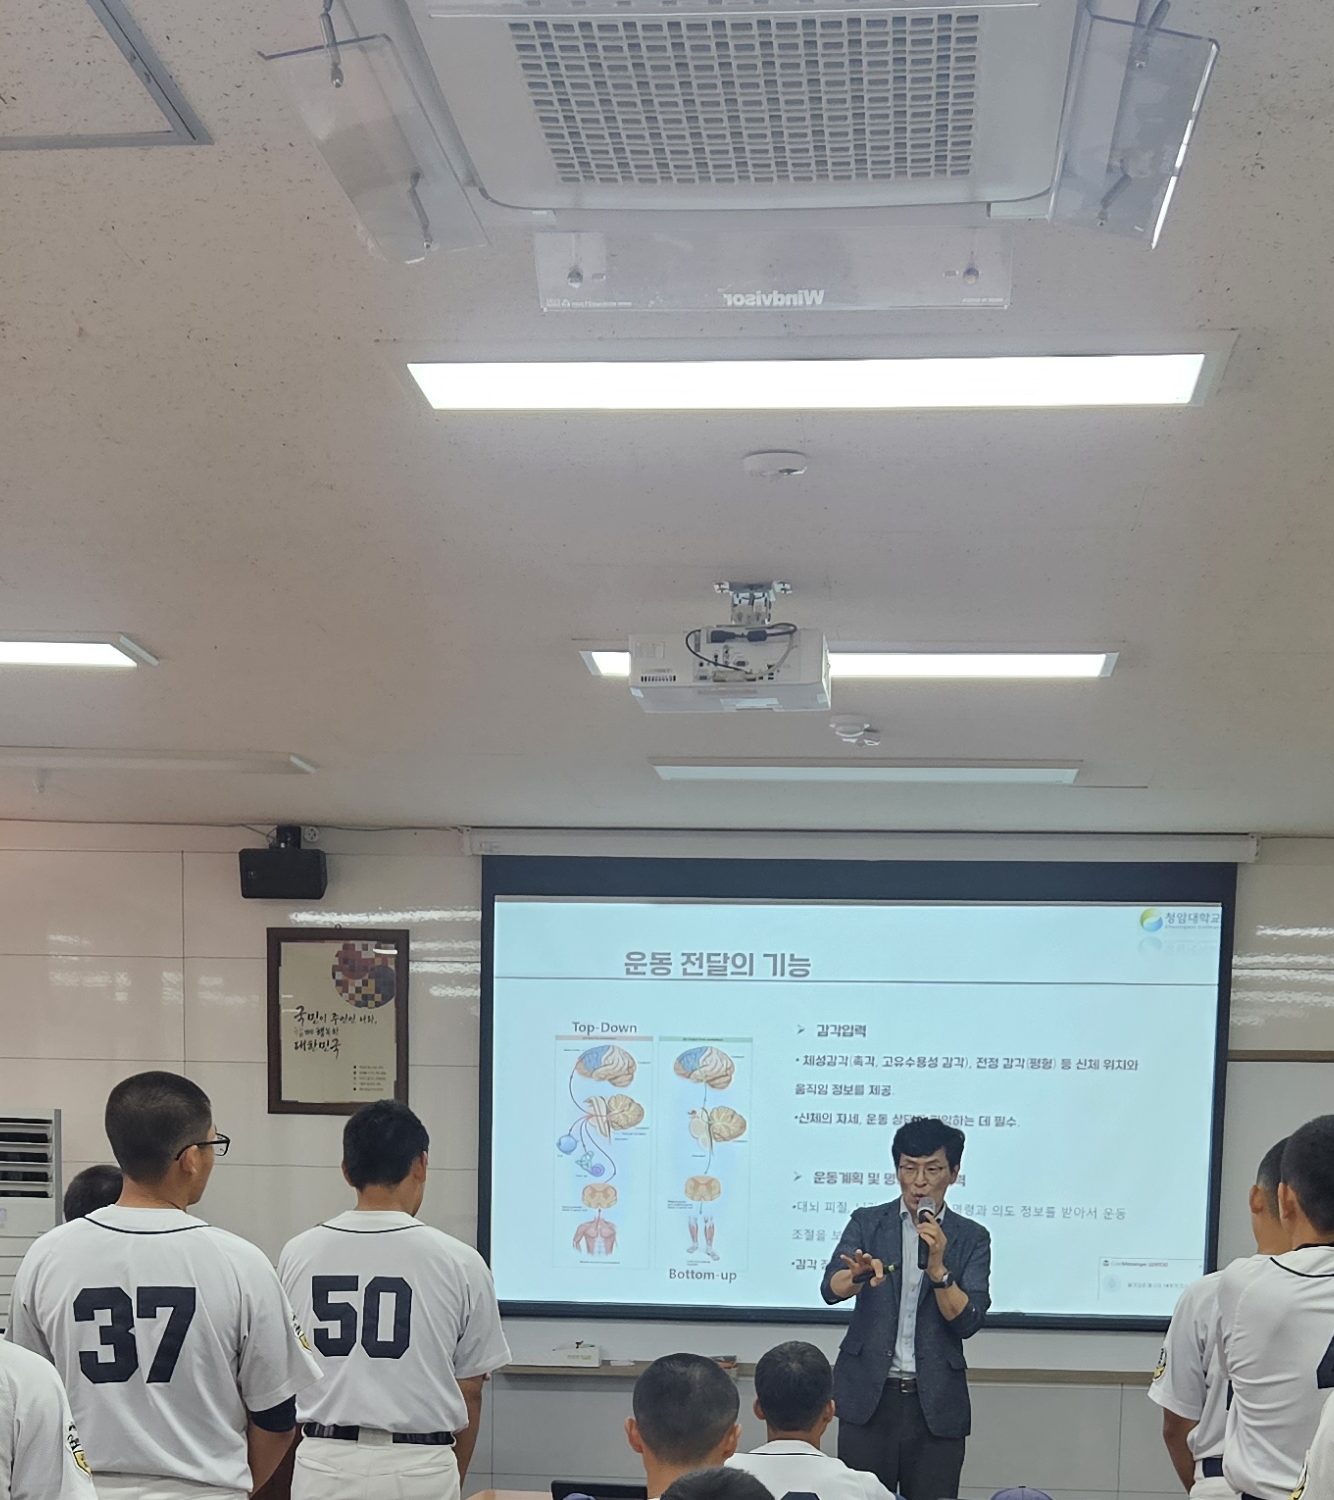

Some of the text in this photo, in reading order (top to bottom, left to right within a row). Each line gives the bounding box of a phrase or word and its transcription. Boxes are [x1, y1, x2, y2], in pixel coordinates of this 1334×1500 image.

[624, 951, 812, 978] 운동 전달의 기능
[293, 1005, 327, 1026] 국민이
[572, 1021, 638, 1036] Top-Down
[817, 1024, 867, 1038] 감각입력
[293, 1038, 341, 1059] 대한민국
[882, 1056, 939, 1069] 고유수용성
[976, 1057, 999, 1070] 전정
[1075, 1058, 1100, 1071] 신체
[1103, 1059, 1139, 1072] 위치와
[795, 1083, 829, 1095] 움직임
[831, 1083, 865, 1096] 정보를
[798, 1112, 833, 1125] 신체의
[866, 1113, 888, 1126] 운동
[978, 1115, 991, 1127] 데
[813, 1171, 864, 1186] 운동계획
[991, 1205, 1016, 1218] 의도
[1020, 1205, 1056, 1219] 정보를
[1061, 1206, 1098, 1220] 받아서
[1103, 1207, 1127, 1221] 운동
[669, 1268, 737, 1284] Bottom-up
[312, 1275, 413, 1360] 50
[73, 1286, 197, 1385] 37
